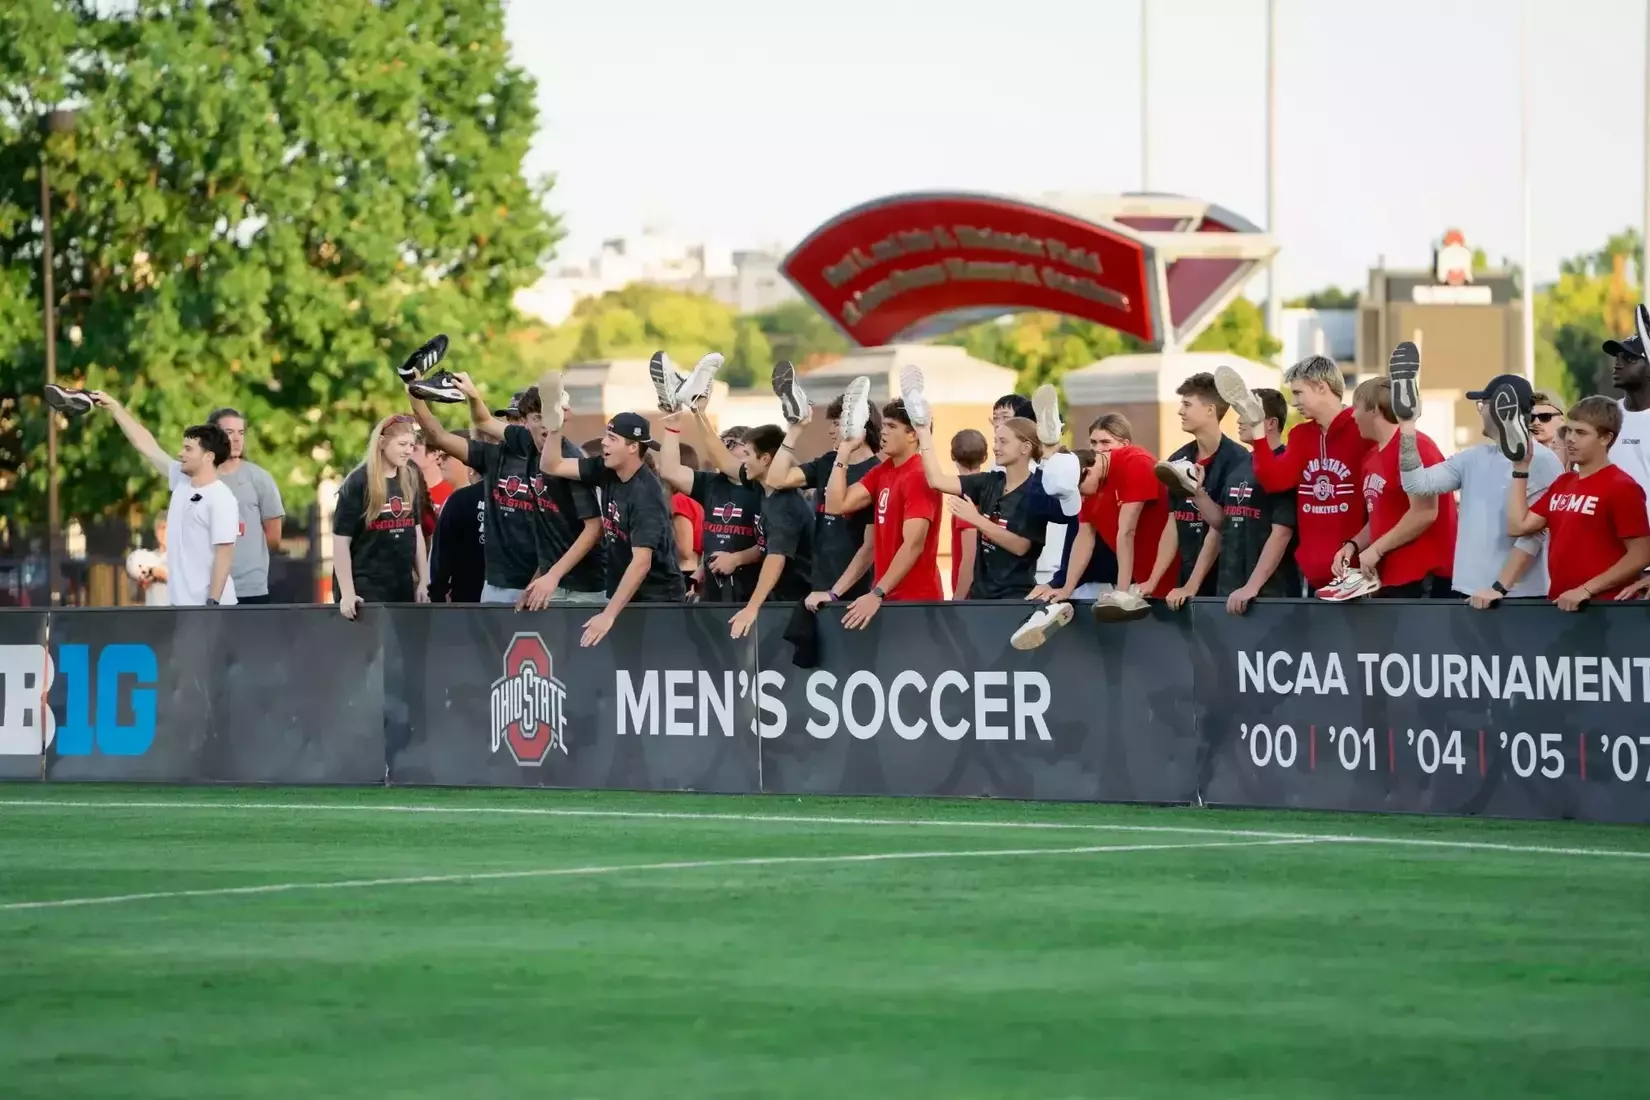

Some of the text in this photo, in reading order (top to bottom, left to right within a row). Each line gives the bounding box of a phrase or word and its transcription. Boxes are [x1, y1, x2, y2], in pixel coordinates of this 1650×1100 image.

[491, 667, 568, 755] OHIO STATE
[615, 669, 1053, 742] MEN’S SOCCER
[1237, 650, 1650, 703] NCAA TOURNAMENT
